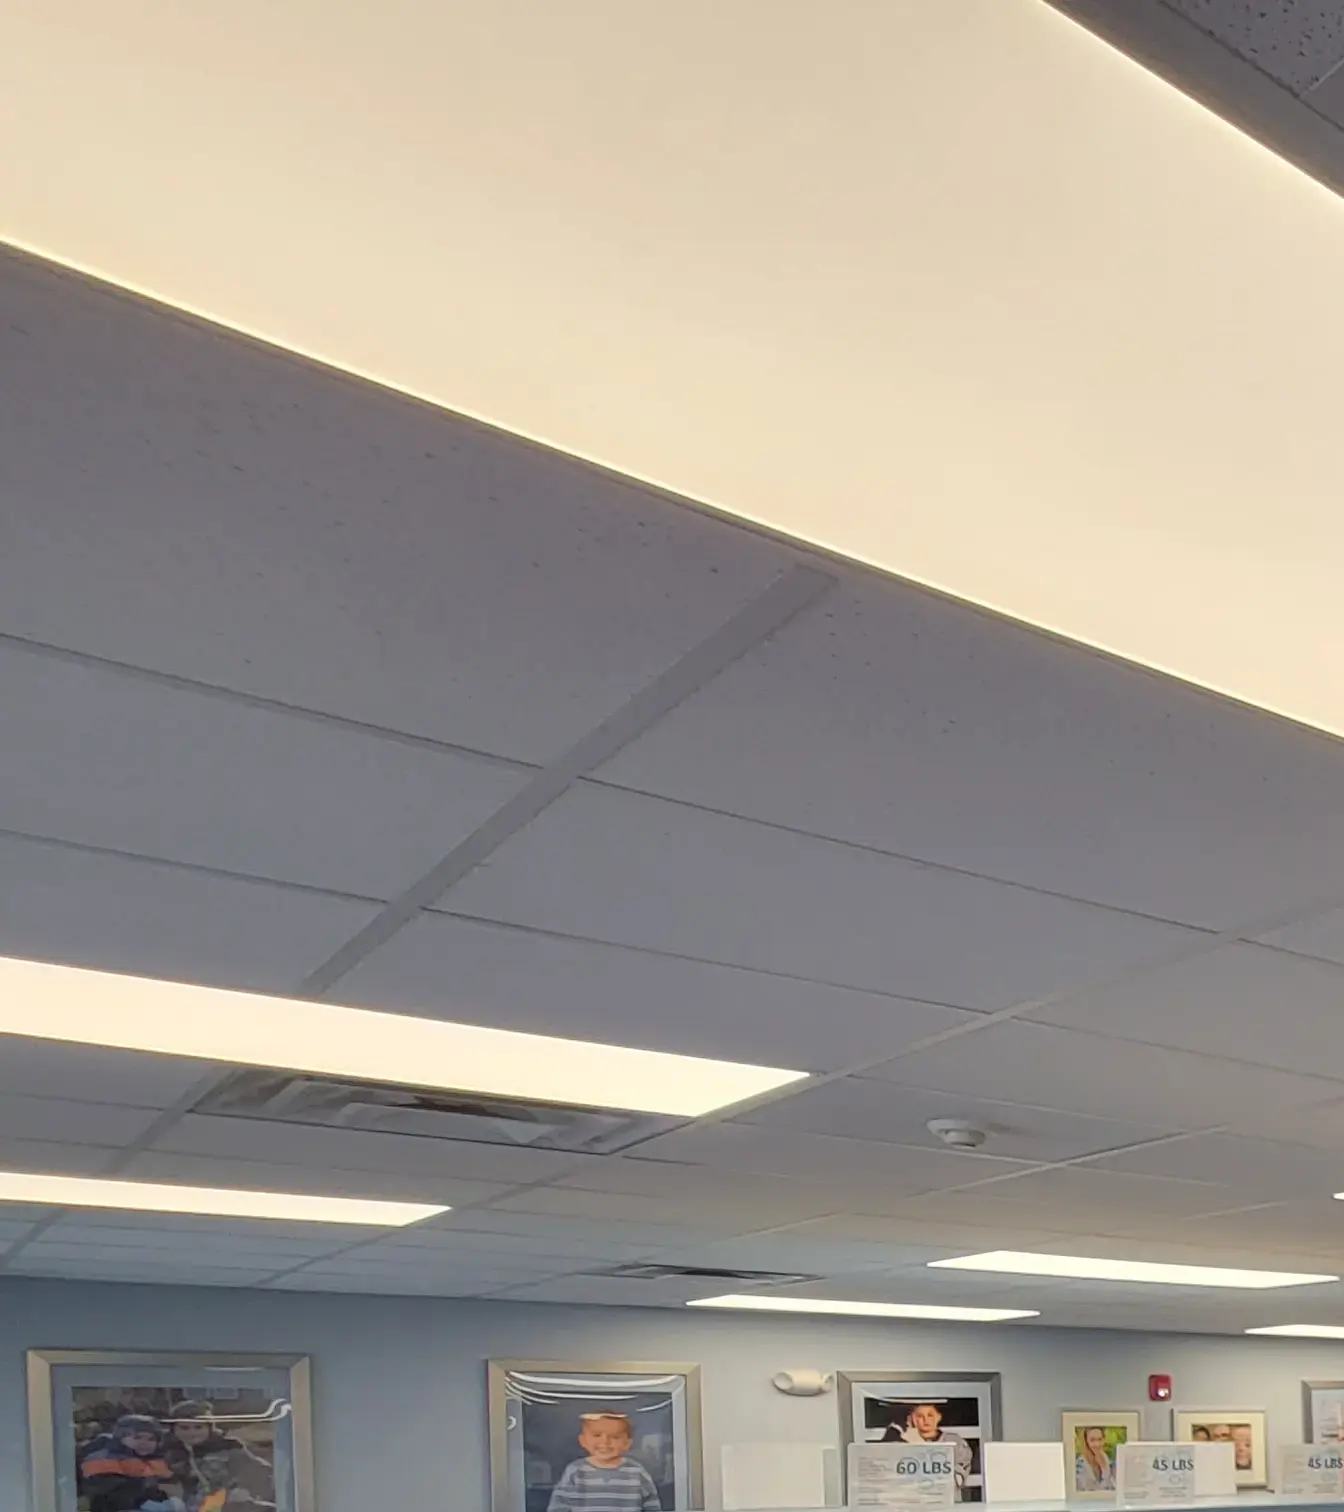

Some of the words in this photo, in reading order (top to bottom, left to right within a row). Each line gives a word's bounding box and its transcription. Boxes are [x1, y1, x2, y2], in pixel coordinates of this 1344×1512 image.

[896, 1461, 917, 1475] 60
[922, 1461, 952, 1475] LBS
[1152, 1457, 1169, 1471] 45
[1172, 1459, 1194, 1471] LBS
[1324, 1457, 1344, 1470] LBS
